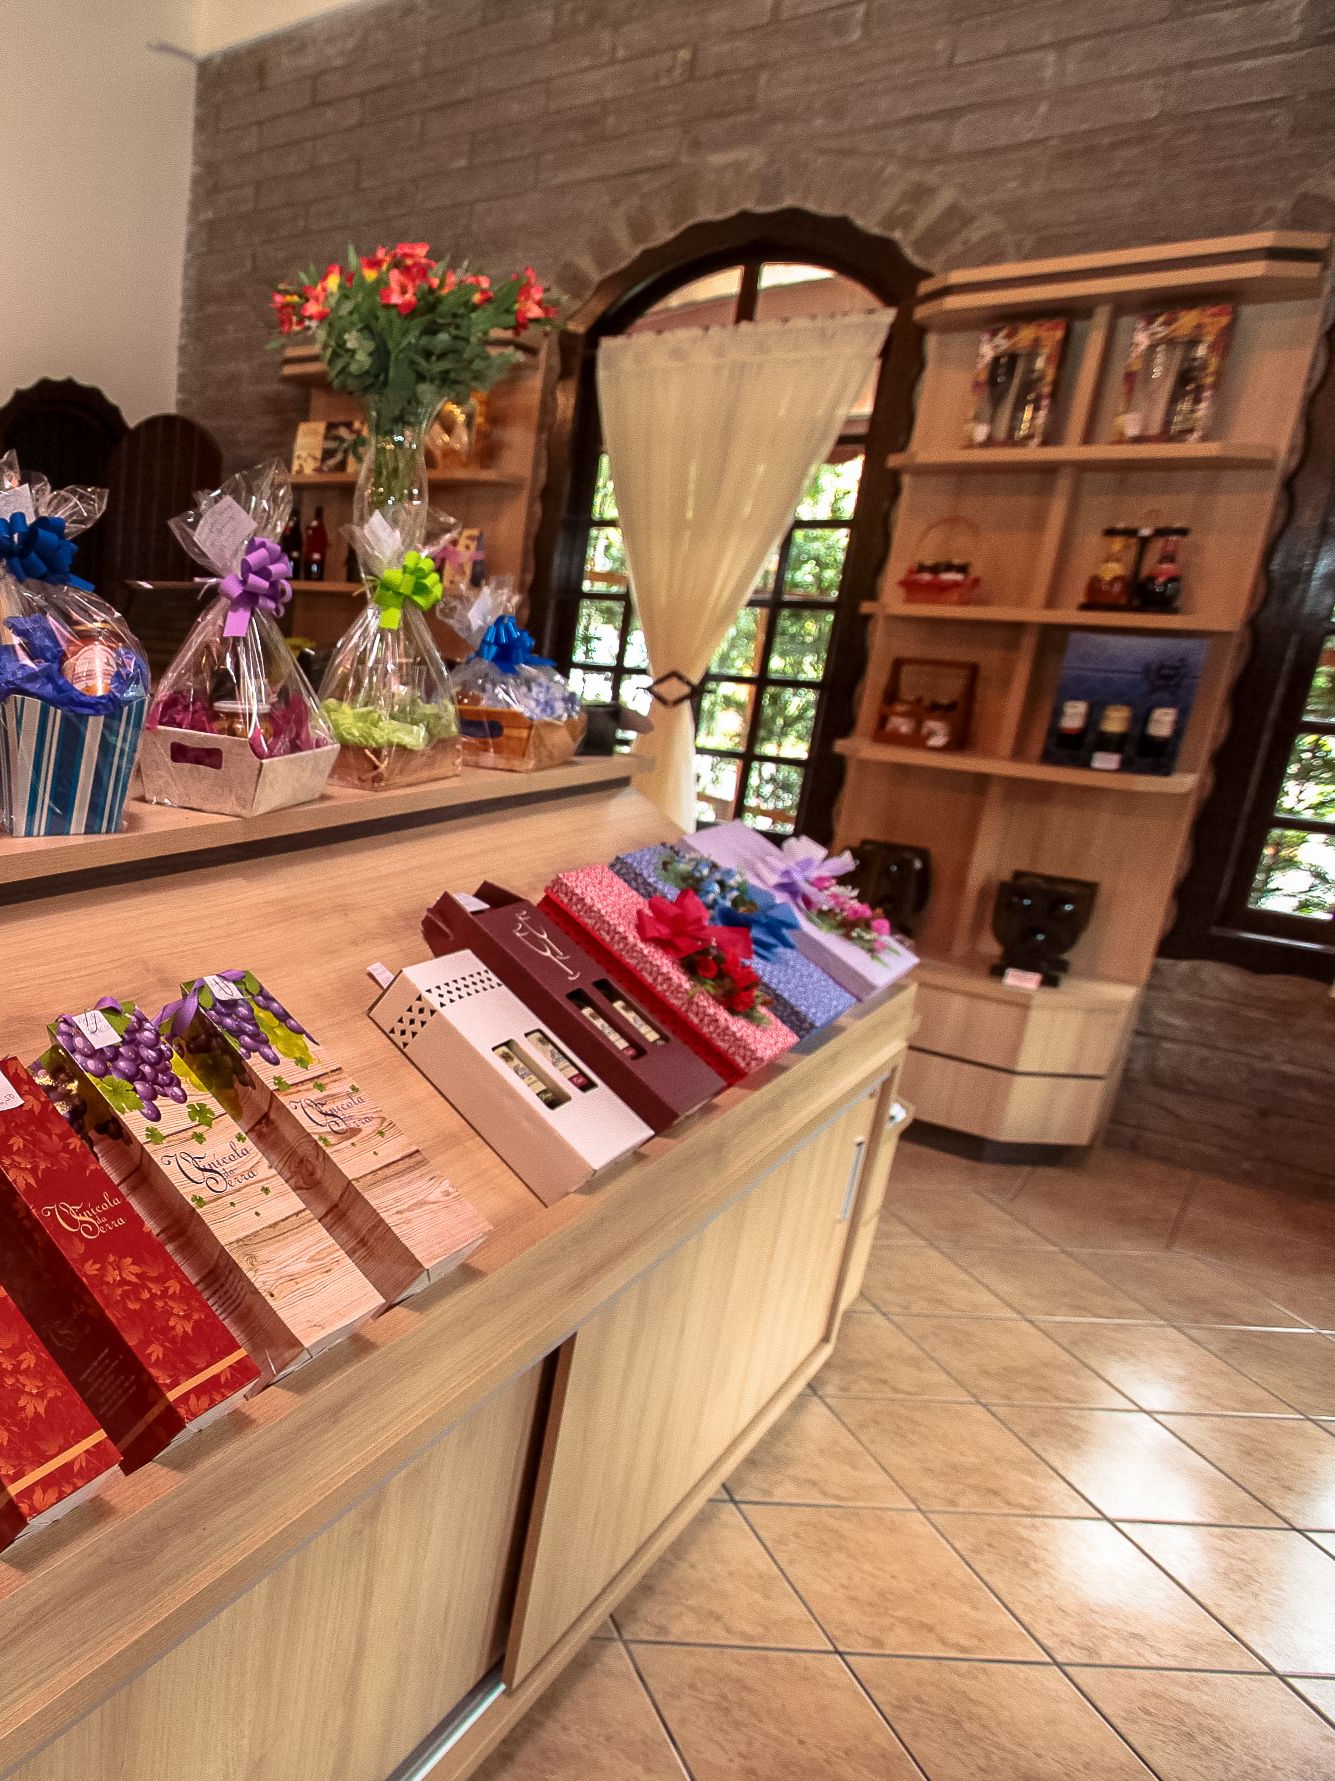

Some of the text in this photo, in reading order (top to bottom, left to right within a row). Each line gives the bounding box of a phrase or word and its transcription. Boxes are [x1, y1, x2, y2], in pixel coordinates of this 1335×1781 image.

[161, 1141, 252, 1184] Vinícola
[194, 1155, 258, 1193] Serra
[42, 1191, 122, 1232] Vinícola
[71, 1205, 125, 1239] Serra
